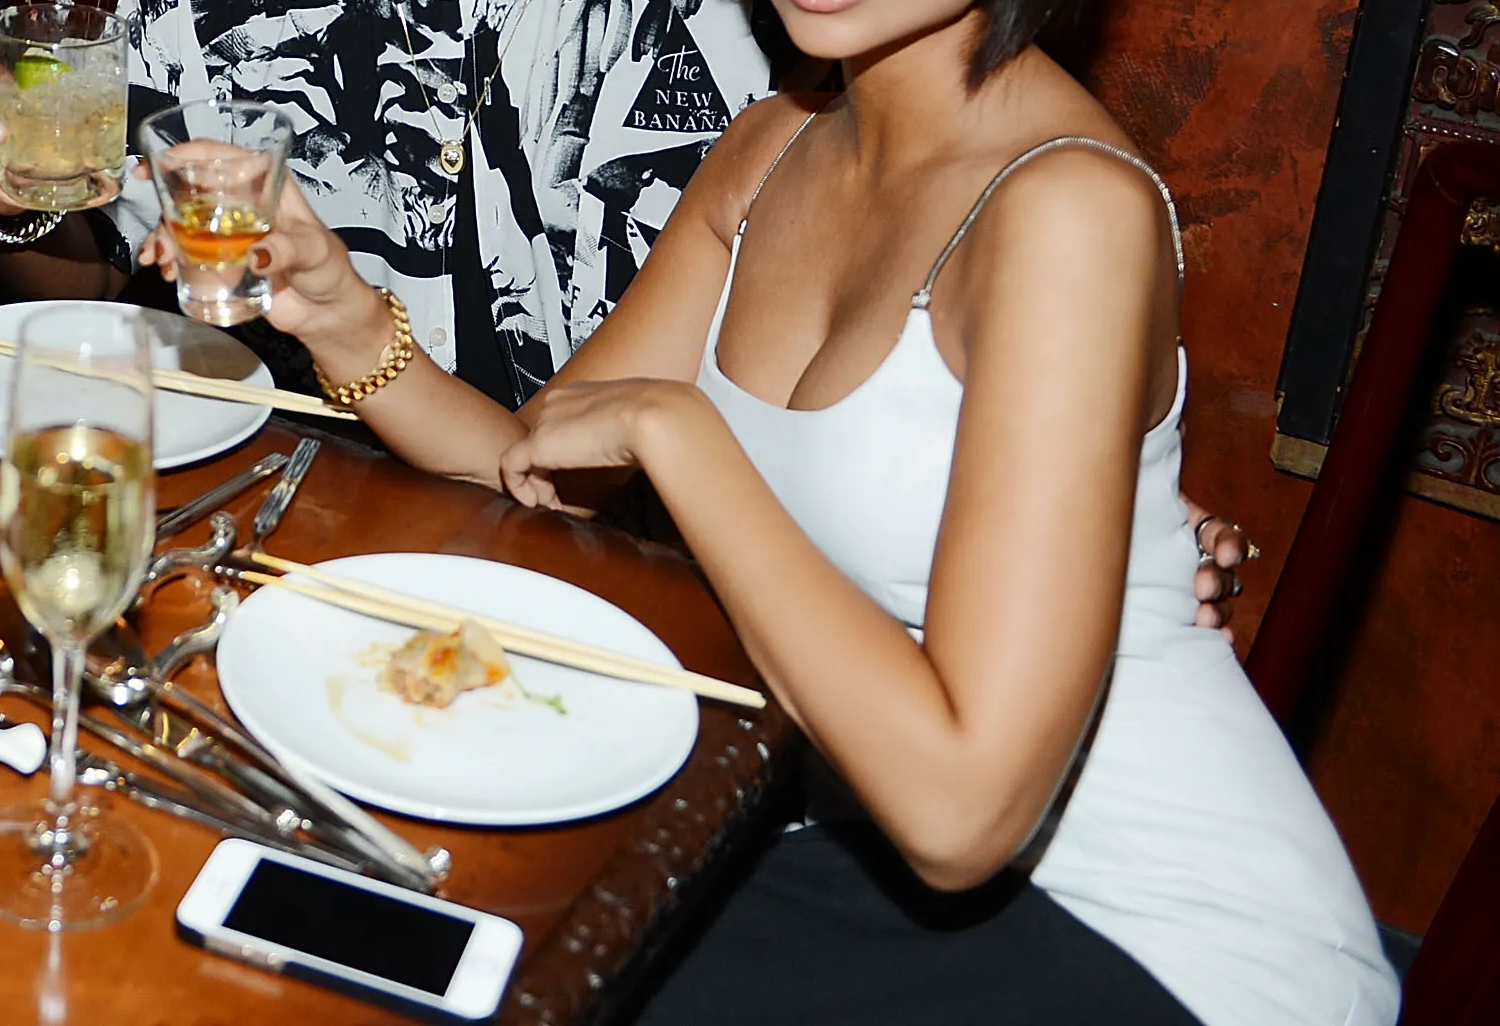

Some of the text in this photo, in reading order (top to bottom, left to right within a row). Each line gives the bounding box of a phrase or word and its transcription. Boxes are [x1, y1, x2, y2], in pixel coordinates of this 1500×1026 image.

[657, 44, 701, 85] The
[655, 89, 713, 107] NEW
[633, 109, 729, 131] BANANA
